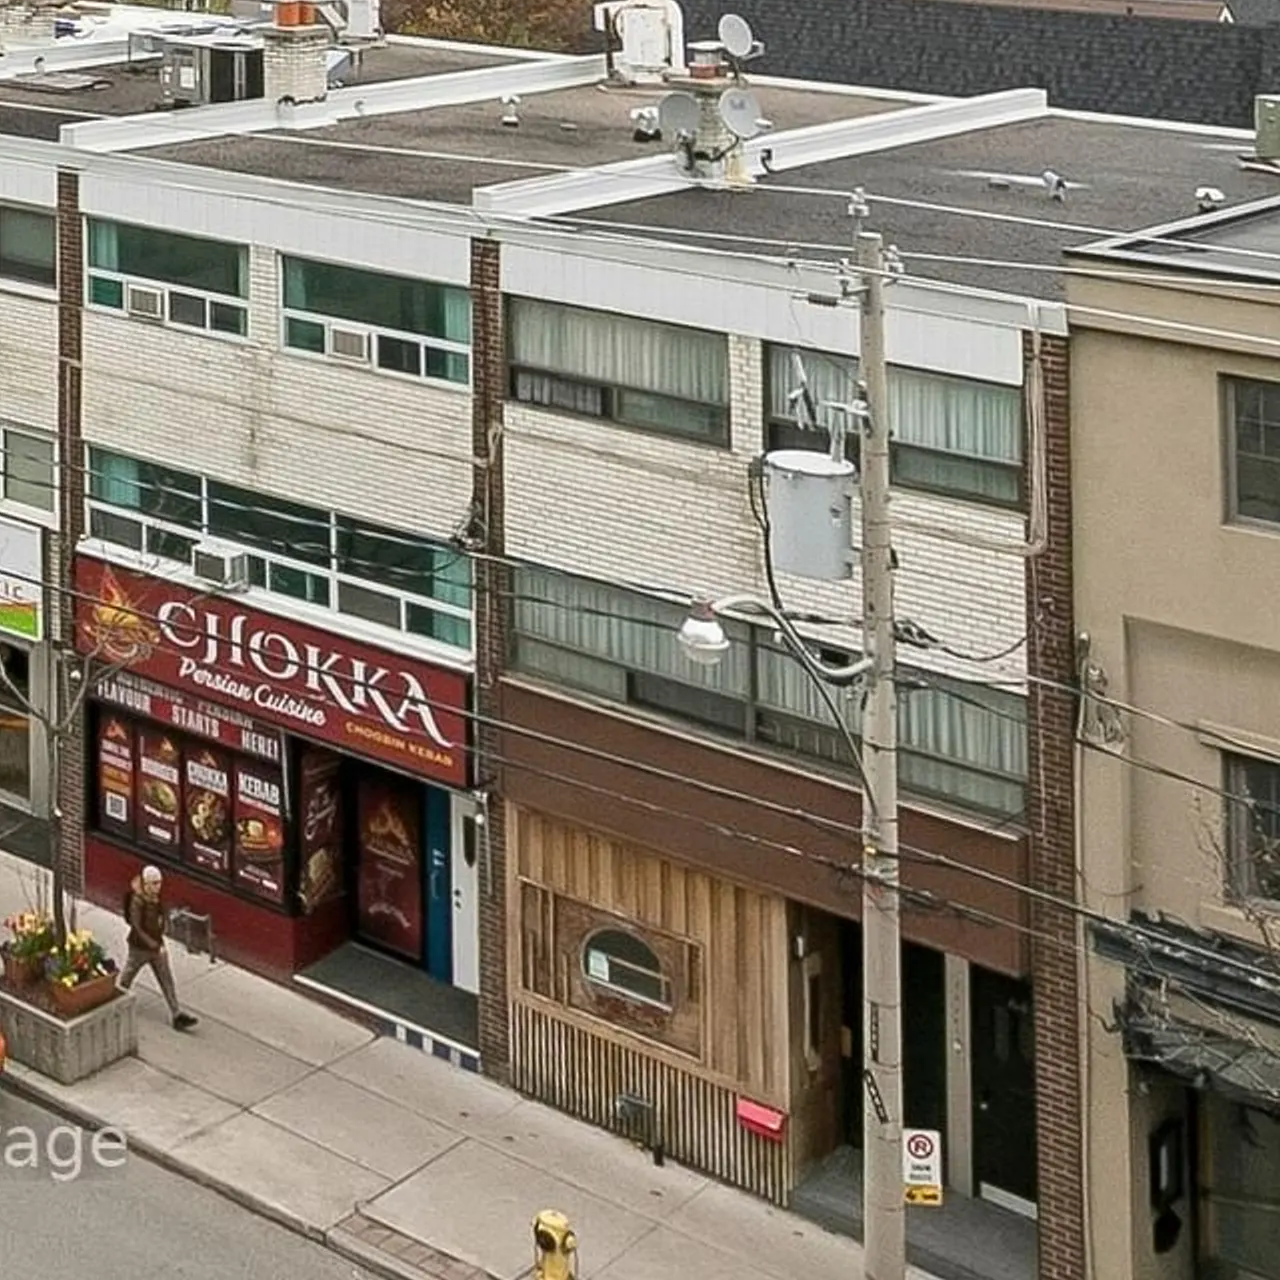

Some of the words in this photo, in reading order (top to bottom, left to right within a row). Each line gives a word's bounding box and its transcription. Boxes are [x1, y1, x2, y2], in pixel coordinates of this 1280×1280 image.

[157, 601, 455, 748] CHOKKA
[178, 657, 252, 702] Persian
[253, 683, 327, 728] Cuisine
[171, 704, 220, 738] STARTS
[241, 730, 279, 761] HERE!
